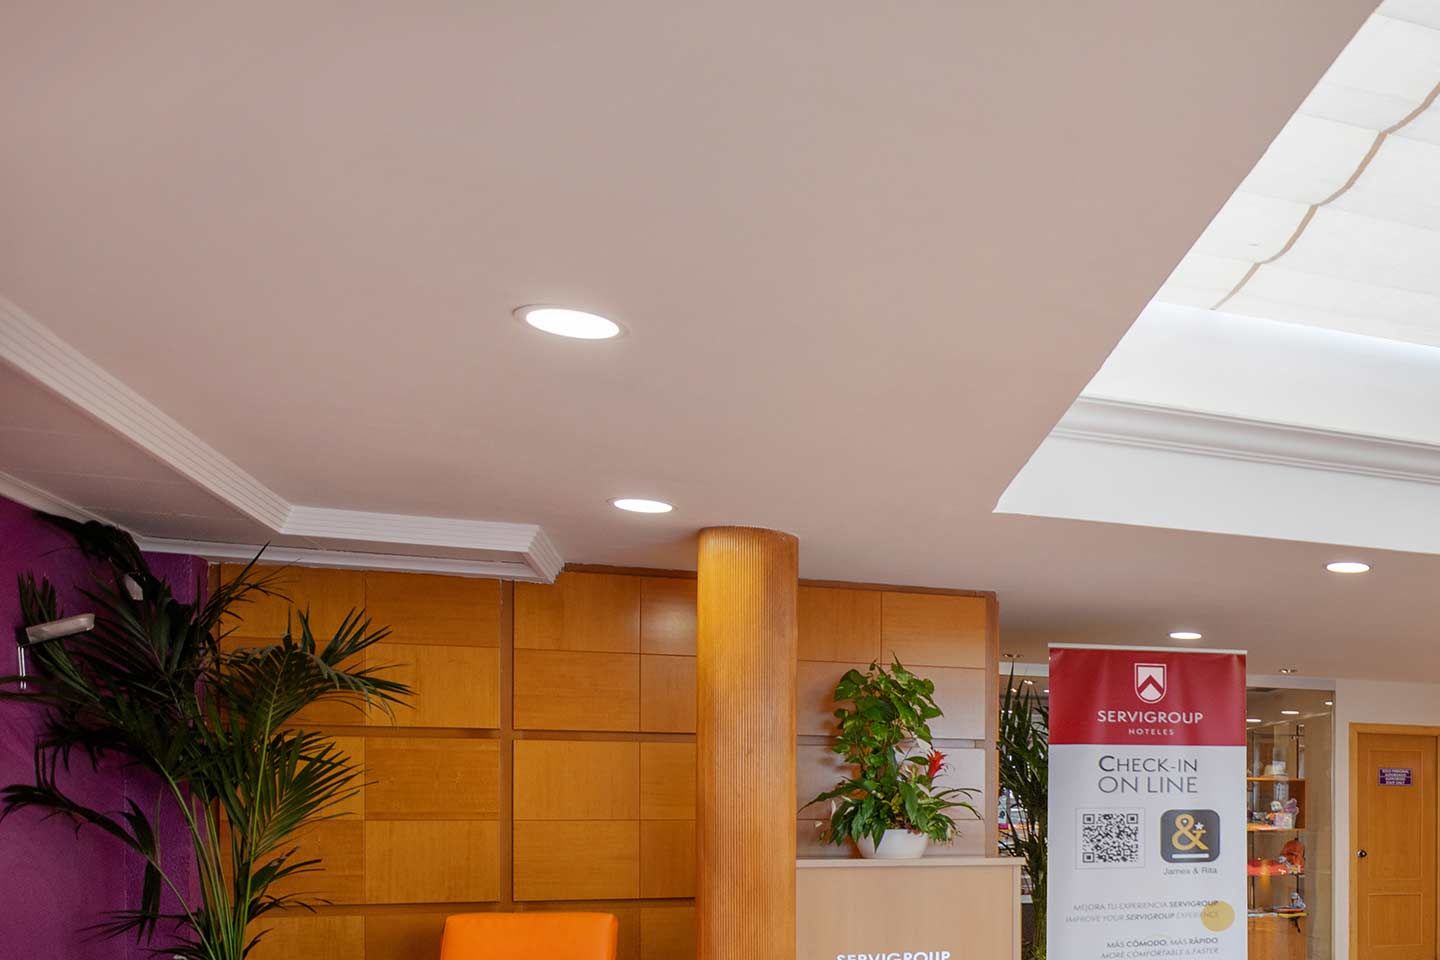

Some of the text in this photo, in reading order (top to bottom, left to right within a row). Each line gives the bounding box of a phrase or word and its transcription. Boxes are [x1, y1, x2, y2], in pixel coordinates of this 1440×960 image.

[1097, 710, 1203, 724] SERVIGROUP
[1128, 728, 1175, 736] HOTELES
[1098, 755, 1197, 773] CHECK-IN
[1098, 776, 1198, 794] ON LINE
[1073, 903, 1105, 911] MEJORA
[1169, 900, 1219, 908] SERVIGROUP
[1103, 914, 1124, 922] YOUR
[1125, 912, 1175, 921] SERVIGROUP
[1189, 936, 1218, 945] RÁPIDO
[1101, 951, 1124, 959] MORE
